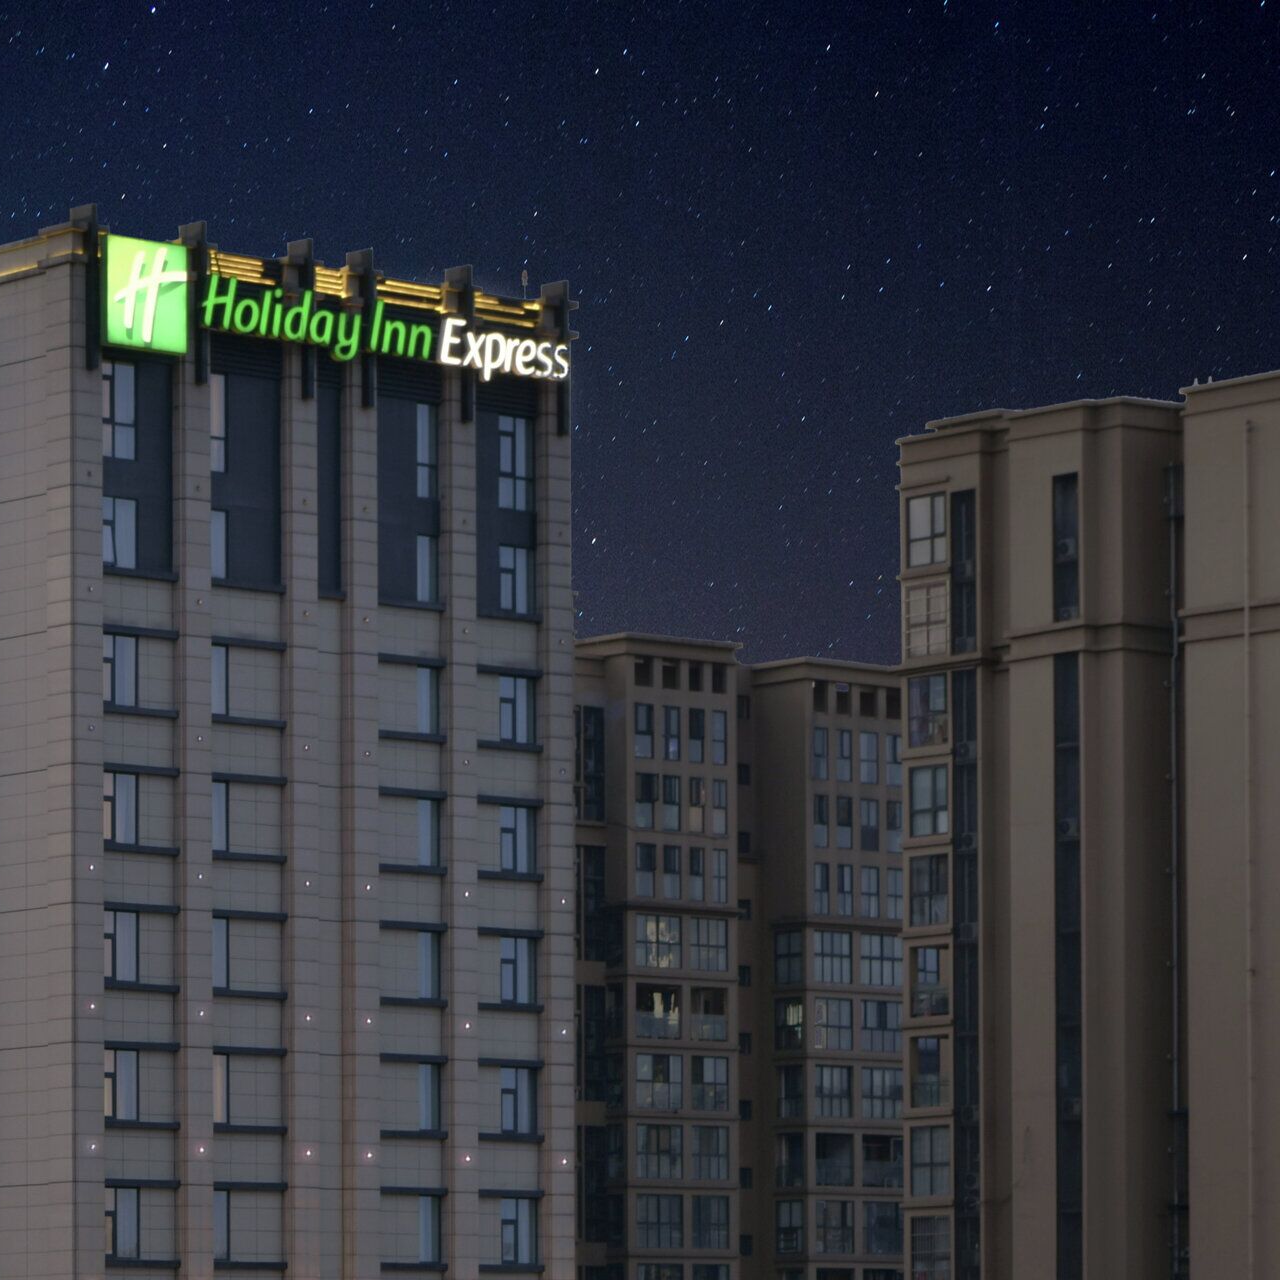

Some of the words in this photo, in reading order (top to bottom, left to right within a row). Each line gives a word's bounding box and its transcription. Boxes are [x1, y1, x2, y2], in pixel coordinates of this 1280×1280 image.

[203, 273, 361, 361] Holiday
[370, 300, 431, 358] Inn
[440, 317, 570, 381] Express
